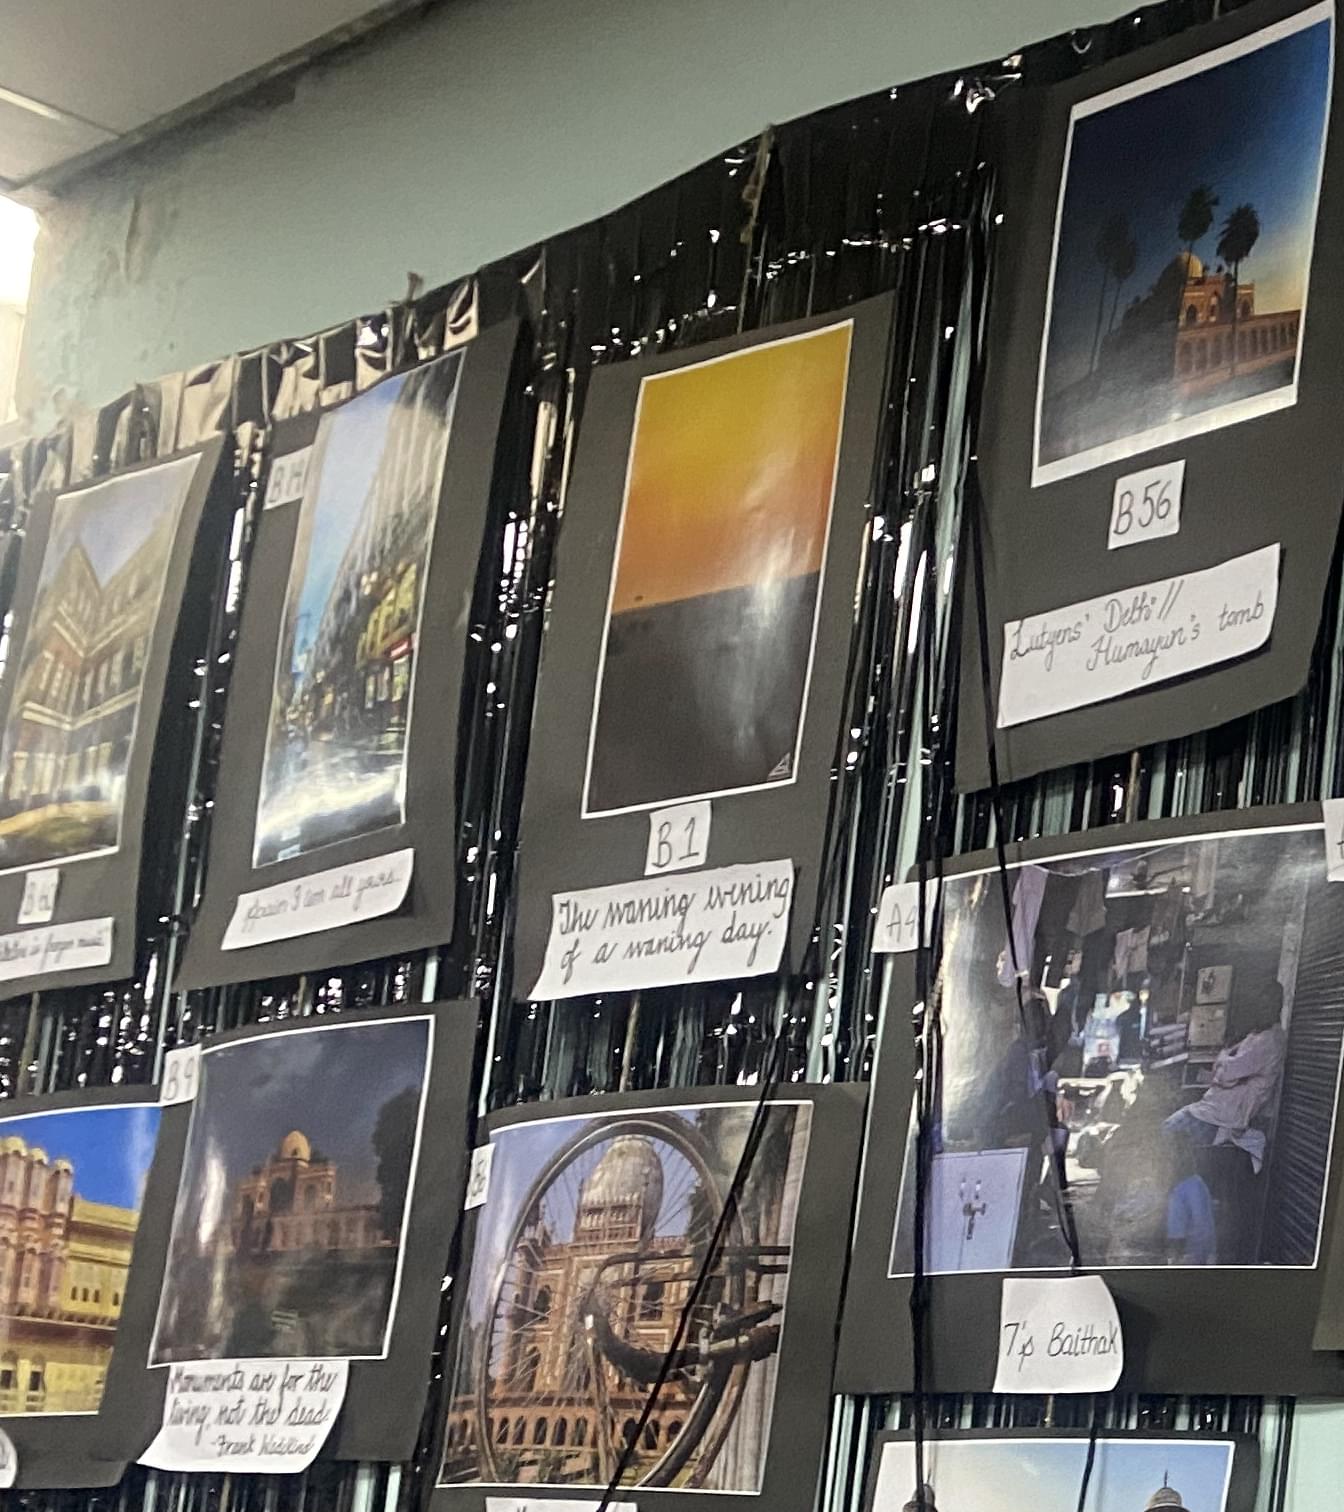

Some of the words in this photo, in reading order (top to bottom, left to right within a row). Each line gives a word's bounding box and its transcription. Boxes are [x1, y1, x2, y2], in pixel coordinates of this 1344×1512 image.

[1113, 480, 1172, 535] B56
[1218, 590, 1264, 632] tomb
[652, 816, 700, 869] B1
[559, 898, 600, 935] The
[602, 887, 697, 934] waning
[703, 873, 790, 918] evening
[560, 939, 582, 985] of
[592, 942, 618, 965] a
[622, 929, 712, 975] waning
[720, 910, 772, 967] day.
[277, 1364, 303, 1415] for
[304, 1363, 338, 1392] the
